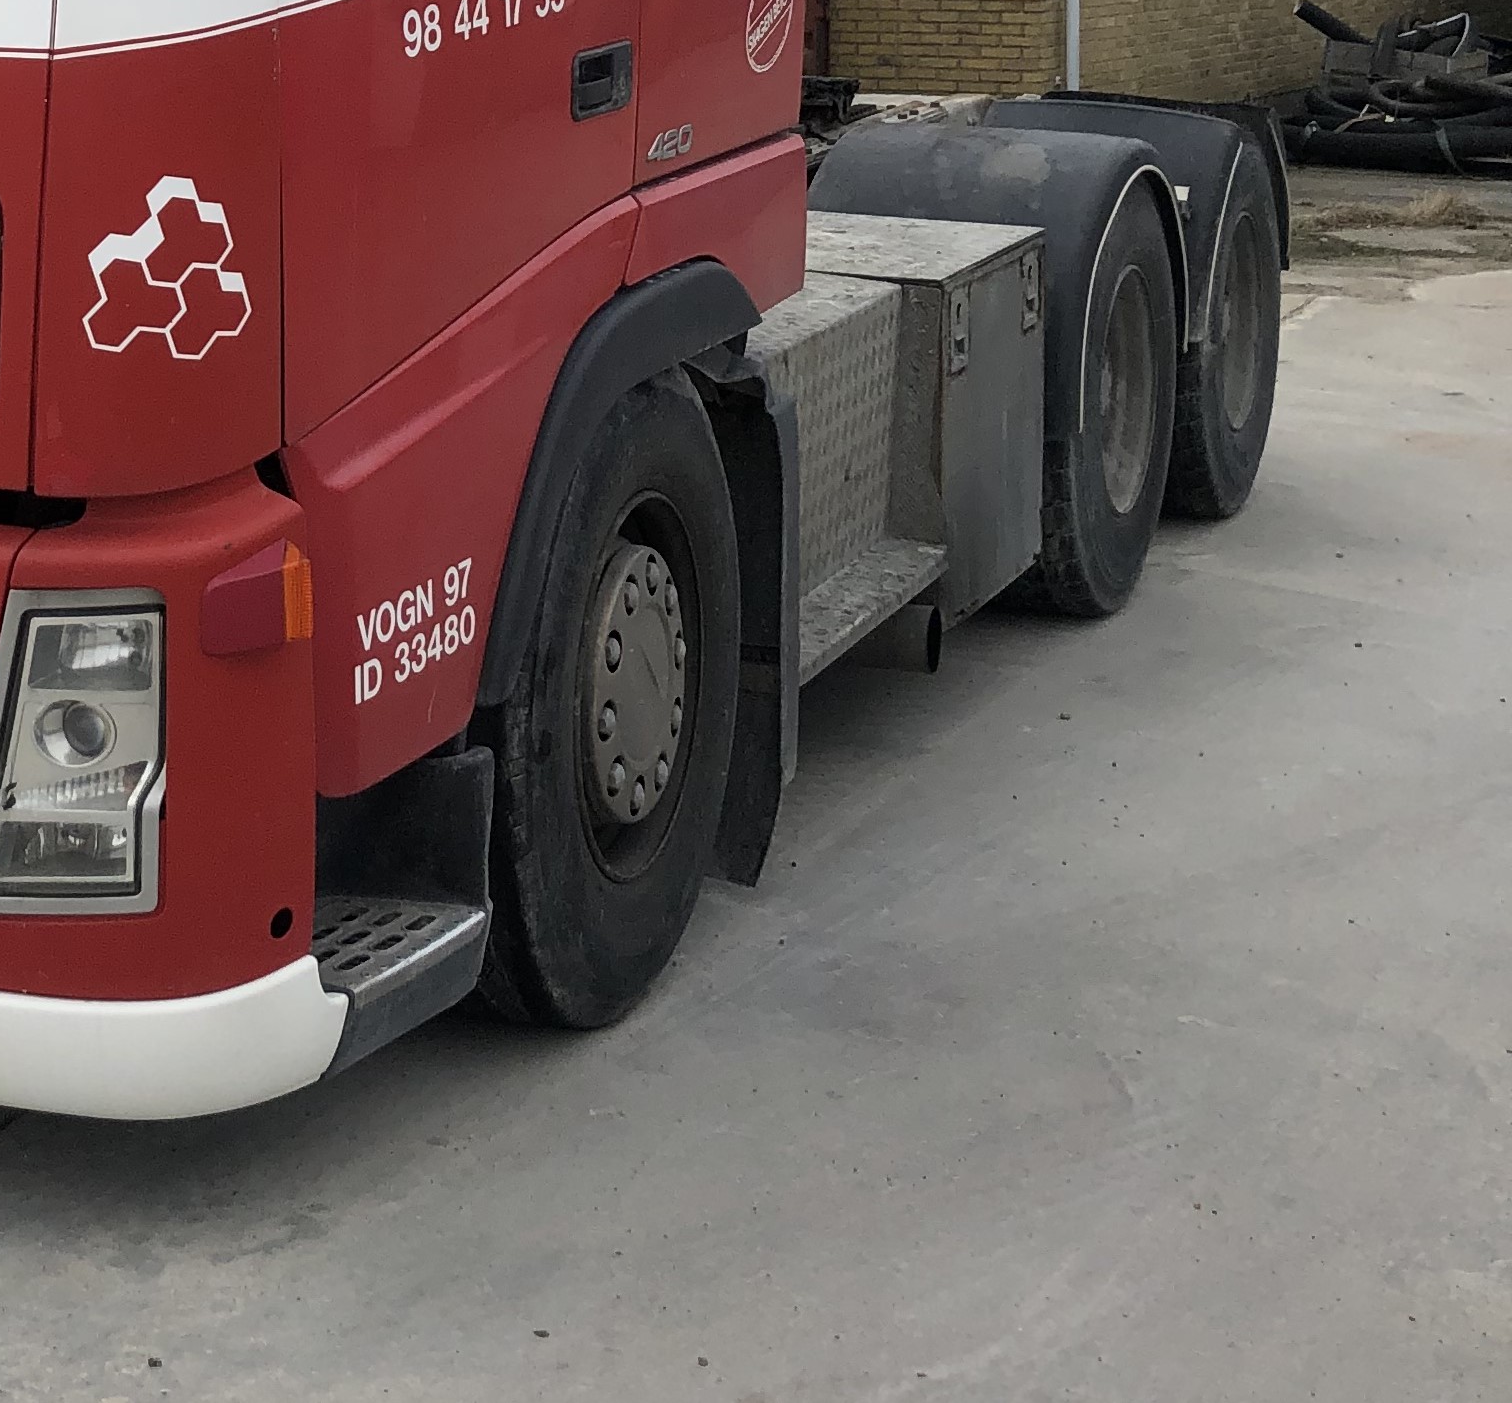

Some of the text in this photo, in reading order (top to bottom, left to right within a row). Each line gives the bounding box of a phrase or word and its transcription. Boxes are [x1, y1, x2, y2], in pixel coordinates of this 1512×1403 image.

[403, 3, 442, 57] 98
[647, 124, 694, 161] 420
[356, 557, 474, 652] VOGN 97
[353, 605, 476, 705] ID 33480
